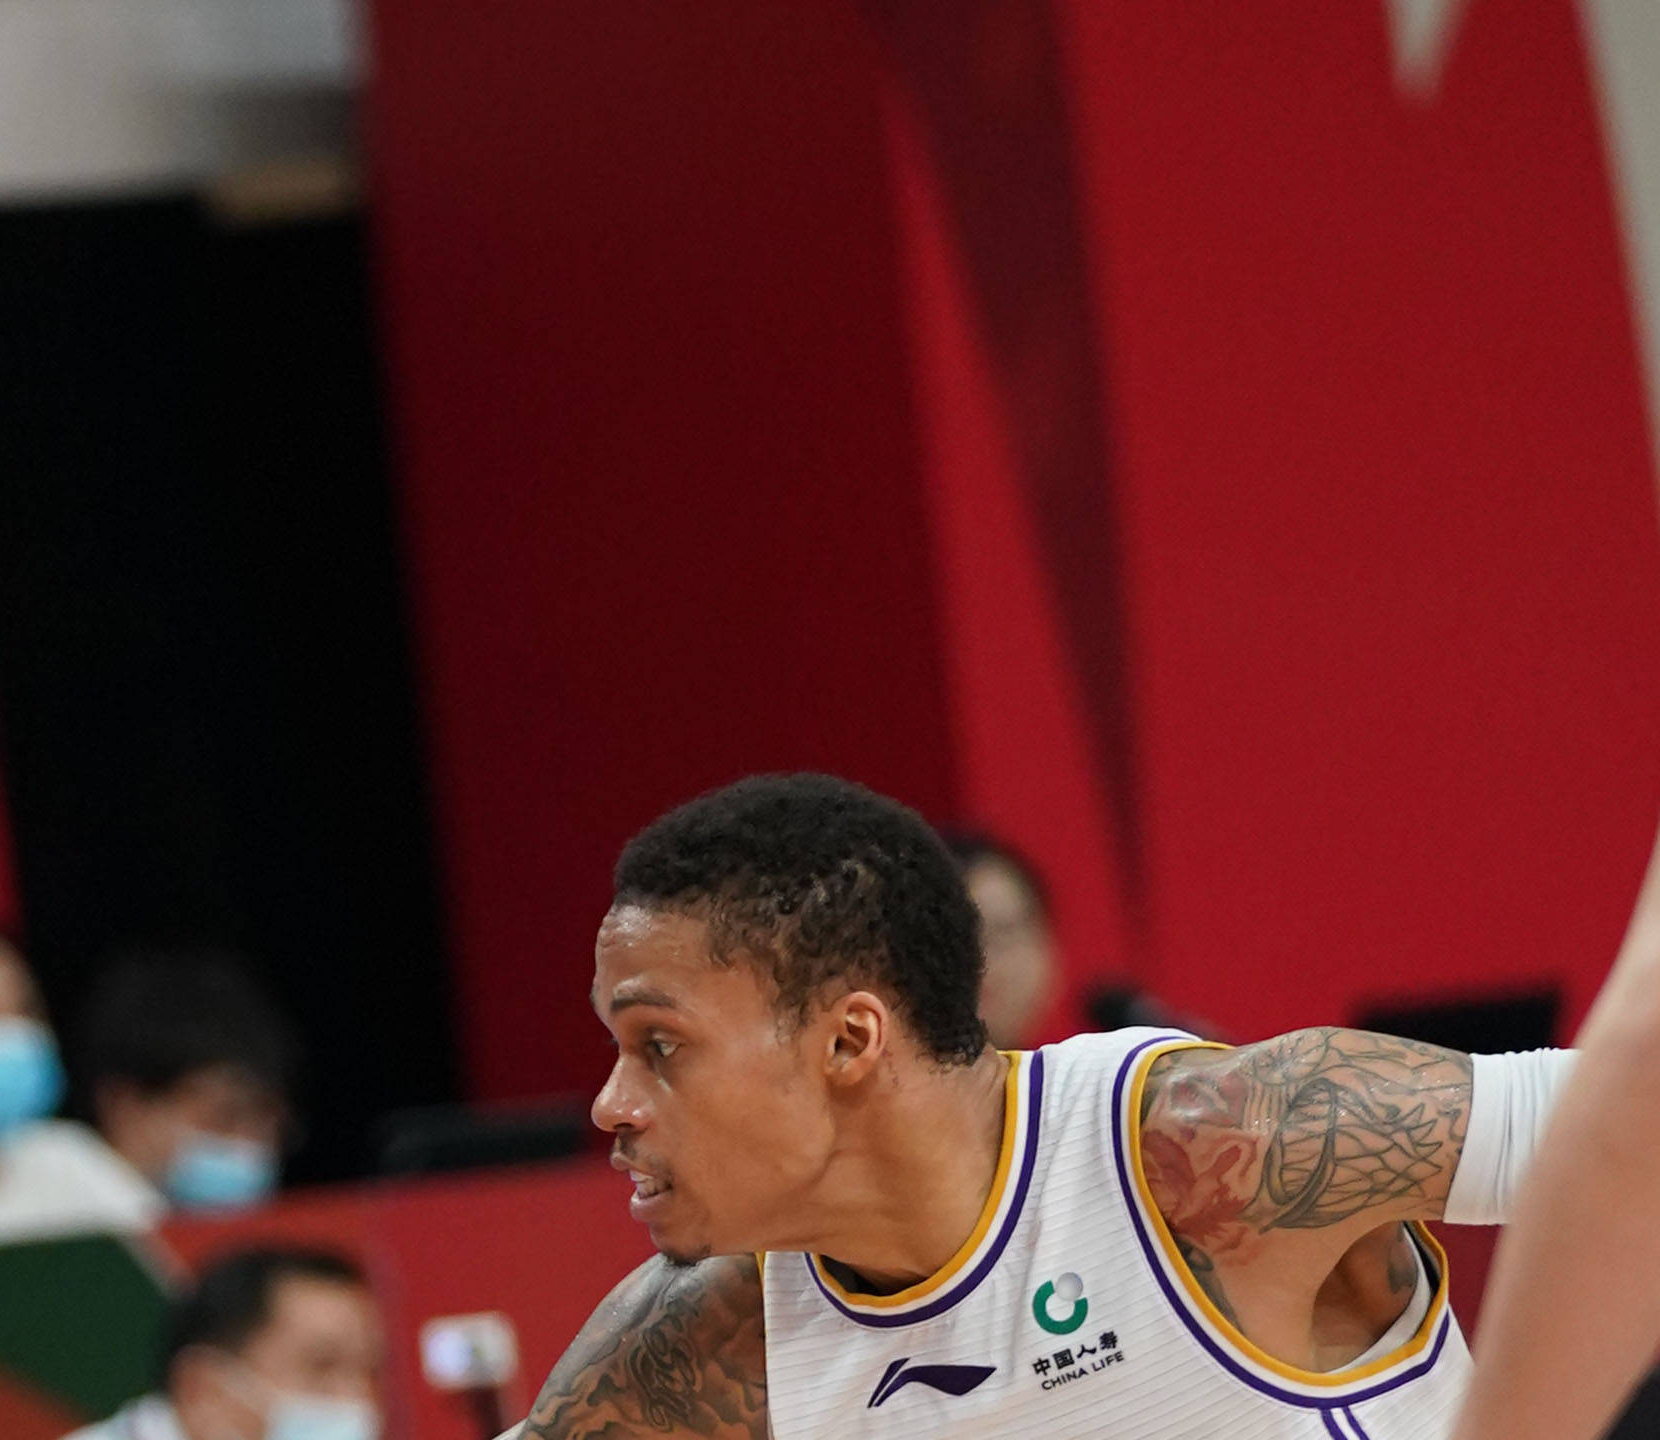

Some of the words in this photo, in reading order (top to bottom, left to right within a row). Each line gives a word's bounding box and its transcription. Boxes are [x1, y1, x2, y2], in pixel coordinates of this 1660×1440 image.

[1032, 1330, 1118, 1377] 中国人寿
[1041, 1367, 1089, 1390] CHINA
[1091, 1350, 1124, 1372] LIFE
